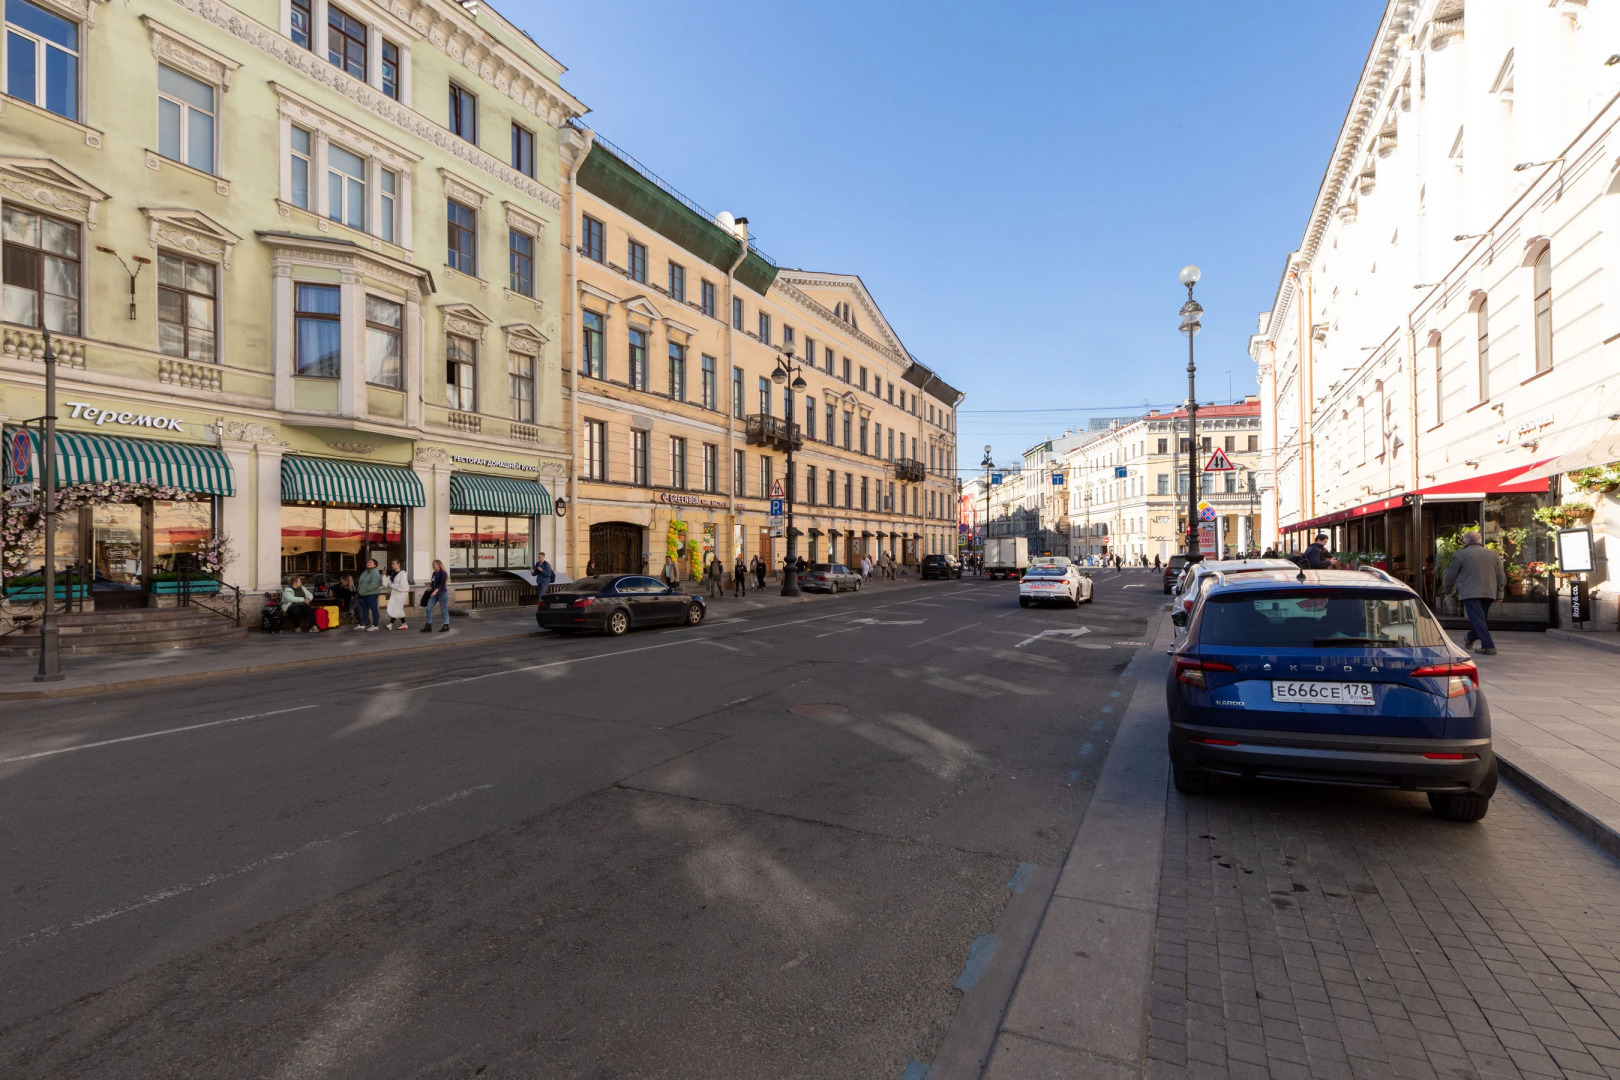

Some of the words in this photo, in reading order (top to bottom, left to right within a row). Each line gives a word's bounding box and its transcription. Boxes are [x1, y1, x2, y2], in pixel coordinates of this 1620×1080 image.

[65, 402, 183, 432] Теремок
[453, 456, 486, 465] РЕСТОРАН
[487, 460, 521, 470] ДОМАШНЕЙ
[1344, 684, 1369, 696] 178
